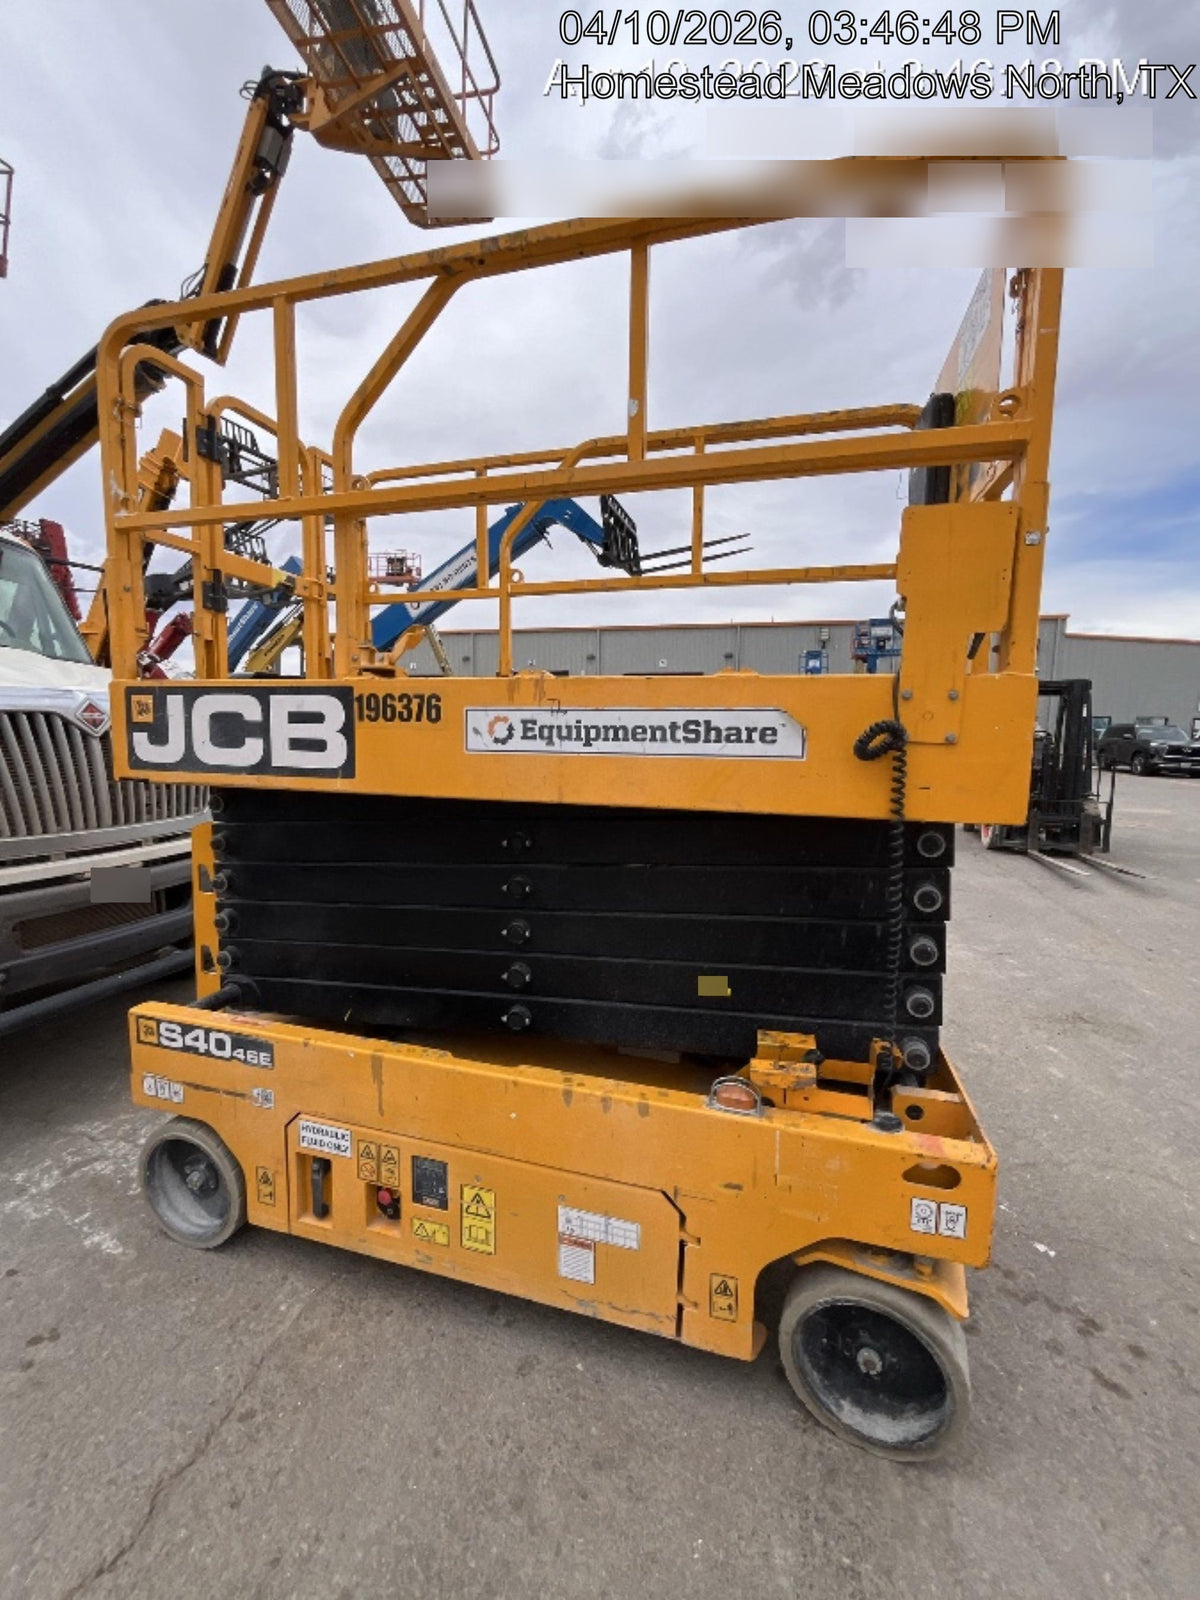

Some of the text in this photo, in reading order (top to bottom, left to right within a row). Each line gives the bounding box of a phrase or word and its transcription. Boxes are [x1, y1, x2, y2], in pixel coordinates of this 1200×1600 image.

[354, 693, 441, 723] 196376
[133, 694, 347, 769] JCB
[520, 719, 778, 747] EquipmentShare
